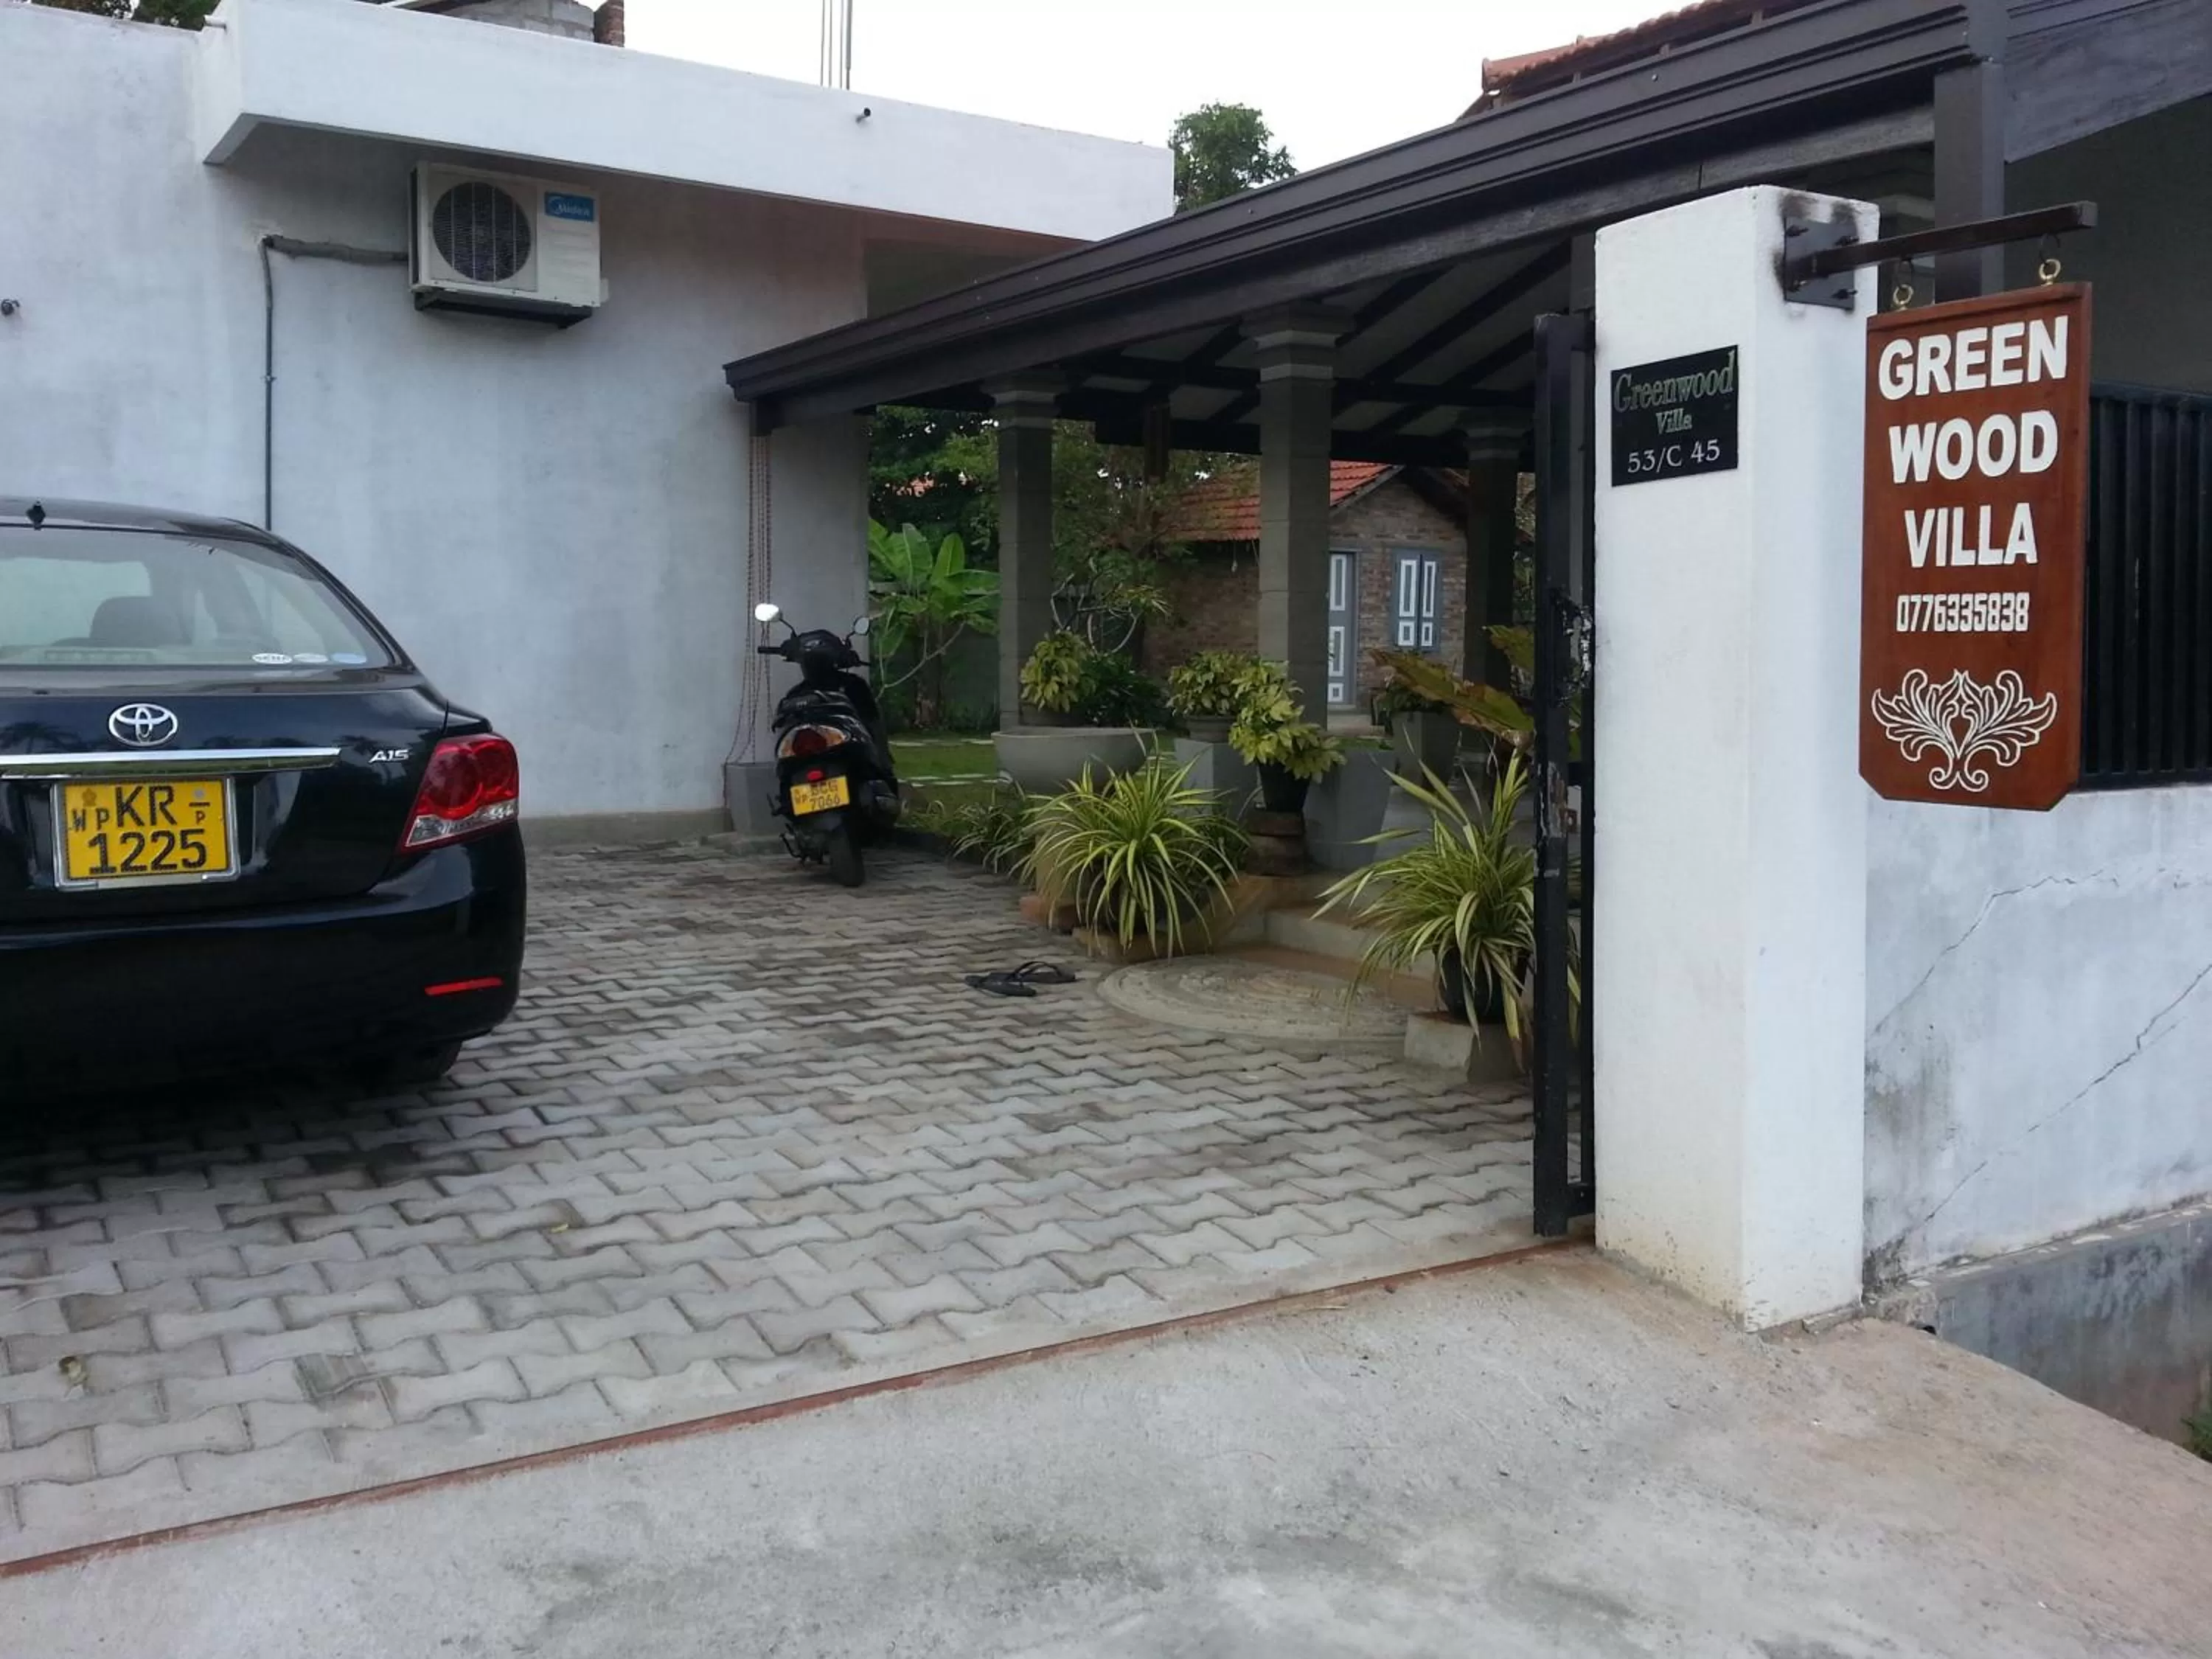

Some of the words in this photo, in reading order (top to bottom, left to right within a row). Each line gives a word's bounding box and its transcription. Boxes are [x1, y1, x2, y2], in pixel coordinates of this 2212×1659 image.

[1878, 315, 2068, 400] GREEN
[1613, 349, 1735, 413] Greenwood
[1655, 408, 1693, 434] Villa
[1627, 444, 1683, 474] 53/C
[1691, 439, 1720, 463] 45
[1888, 409, 2058, 484] WOOD
[1904, 502, 2039, 568] VILLA
[1896, 592, 2030, 632] 0776335838
[368, 749, 409, 763] A15
[114, 785, 178, 828] KR
[88, 828, 207, 875] 1225
